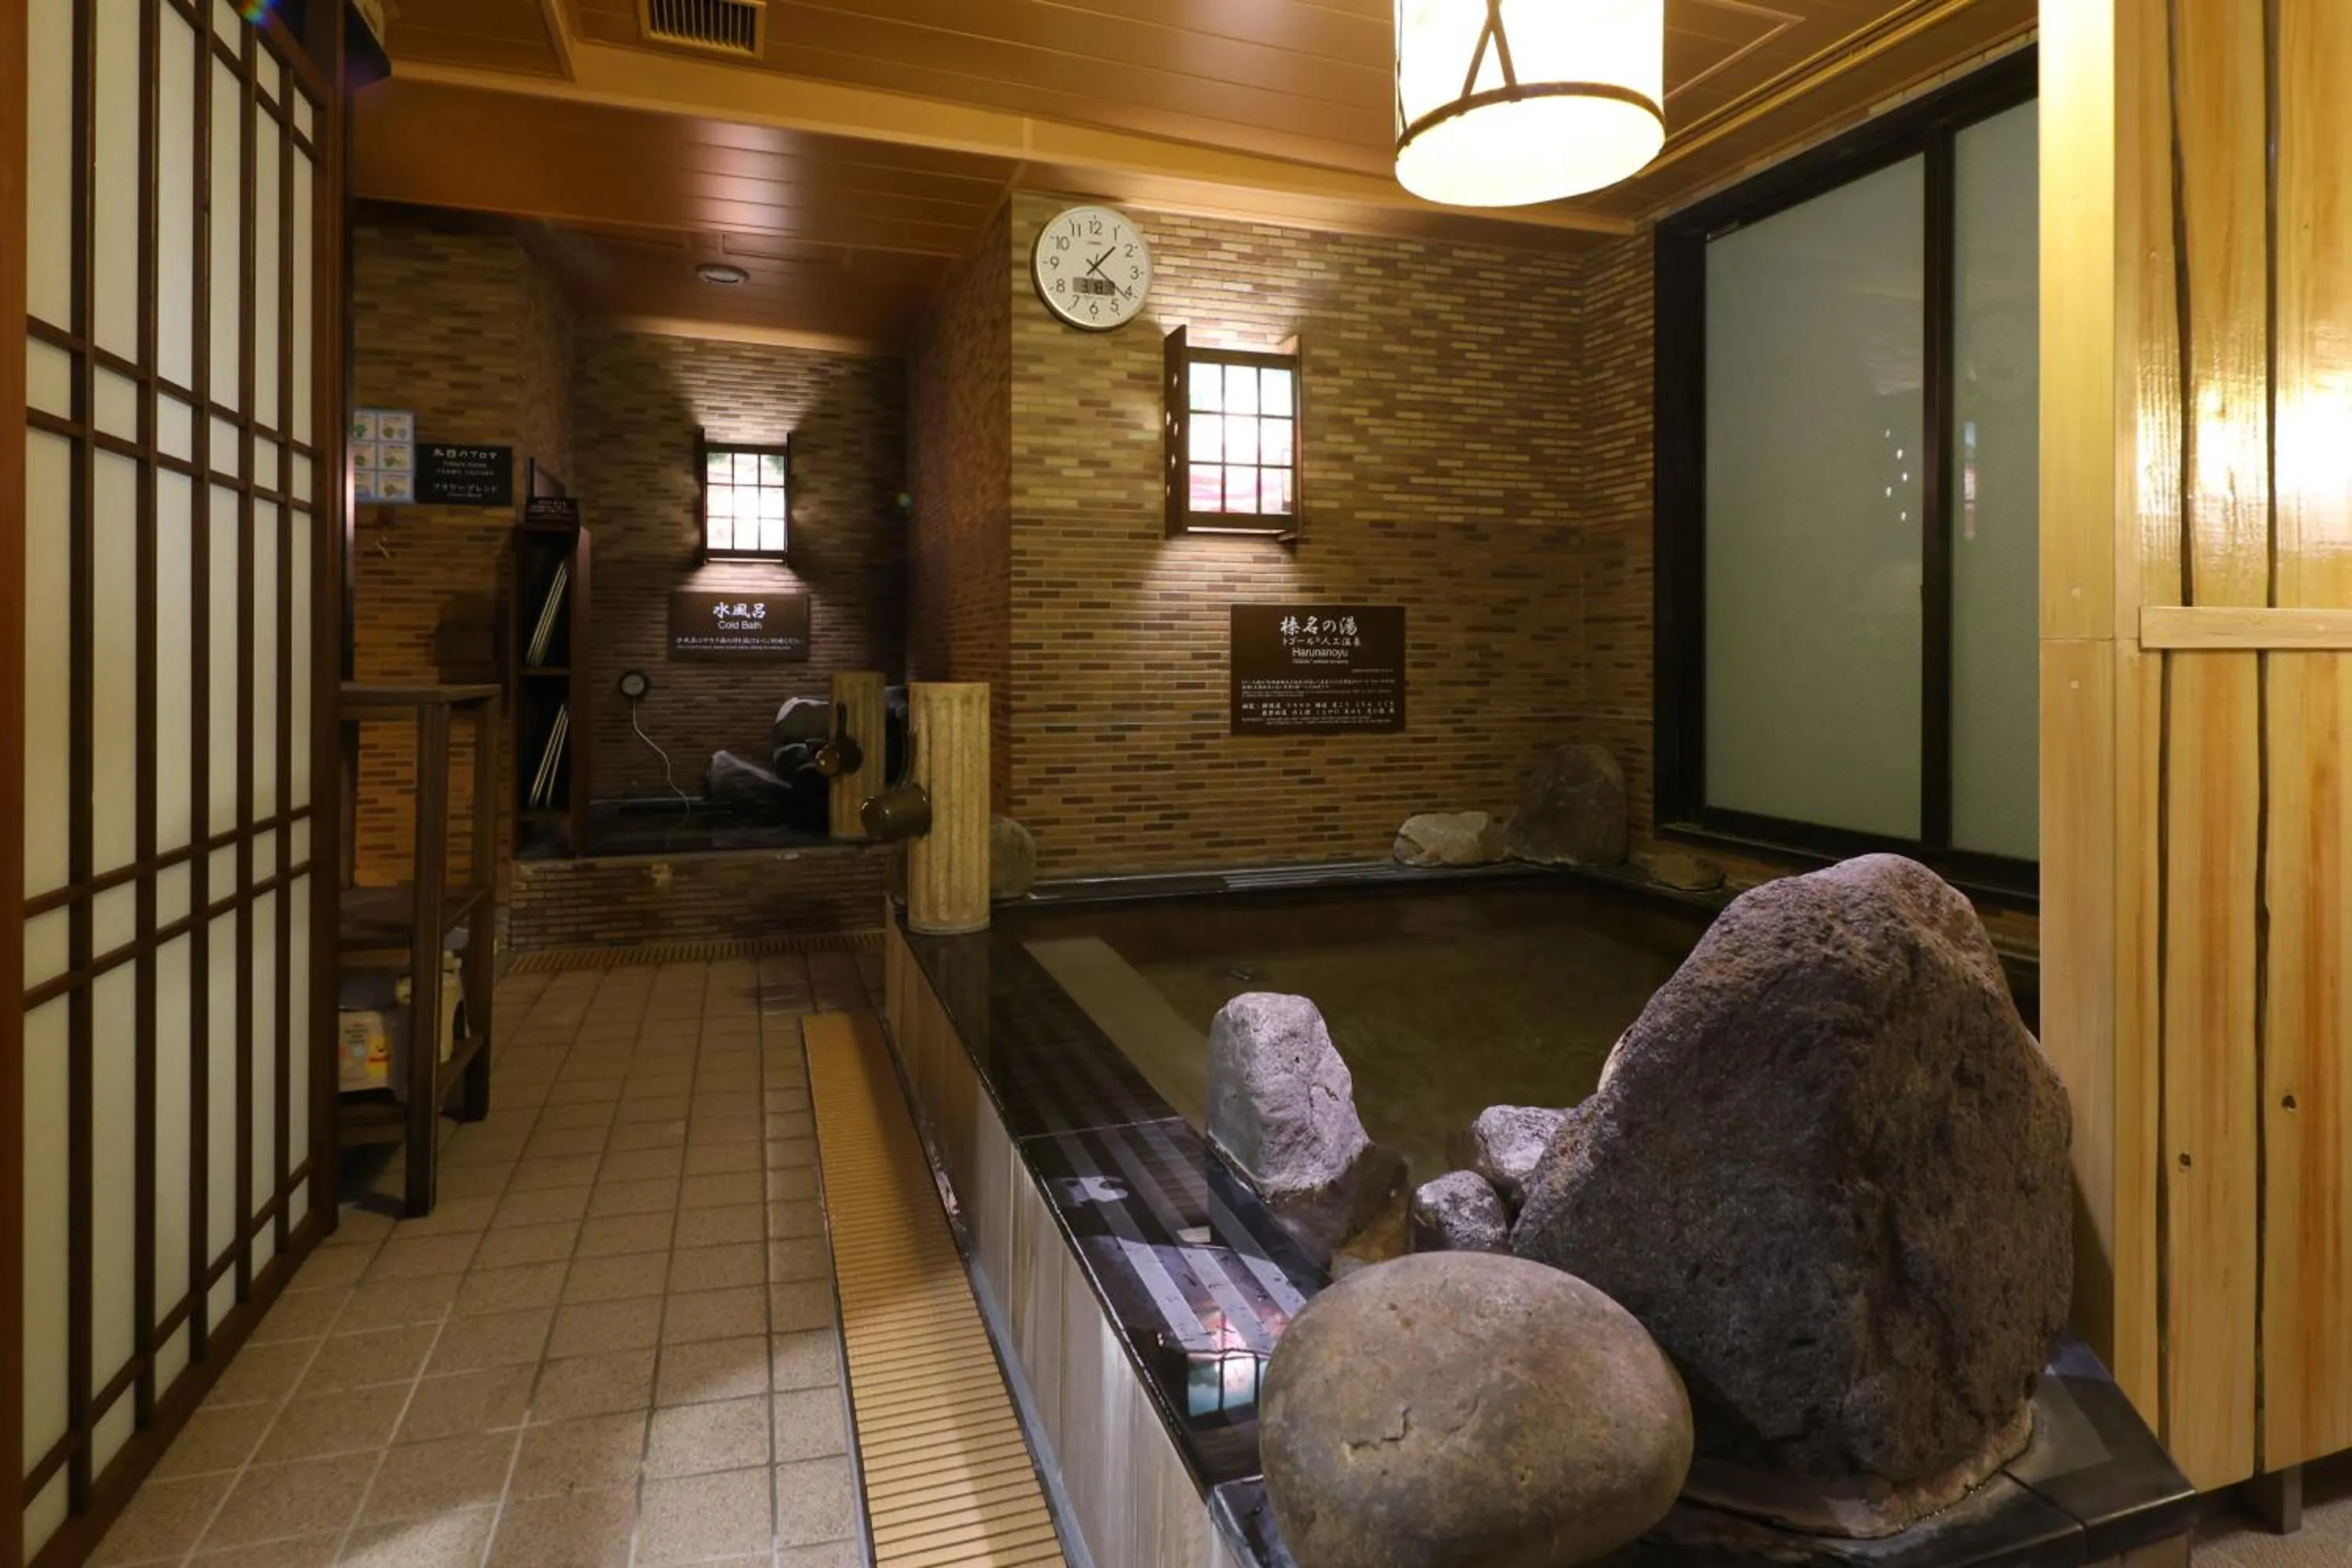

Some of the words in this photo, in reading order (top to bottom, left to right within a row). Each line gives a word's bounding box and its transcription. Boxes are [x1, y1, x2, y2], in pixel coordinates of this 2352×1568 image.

[1071, 223, 1081, 237] 11
[1089, 220, 1102, 235] 12
[1055, 236, 1069, 251] 10
[1124, 244, 1134, 257] 2
[1050, 256, 1059, 269] 9
[1130, 266, 1139, 279] 3
[1056, 278, 1065, 292] 8
[1124, 285, 1133, 297] 4
[1072, 295, 1080, 309] 7
[1090, 301, 1098, 314] 6
[1110, 298, 1119, 312] 5
[713, 601, 766, 619] 水風呂
[717, 620, 739, 630] Cold
[741, 620, 763, 630] Bath
[1279, 615, 1358, 636] 榛名の湯
